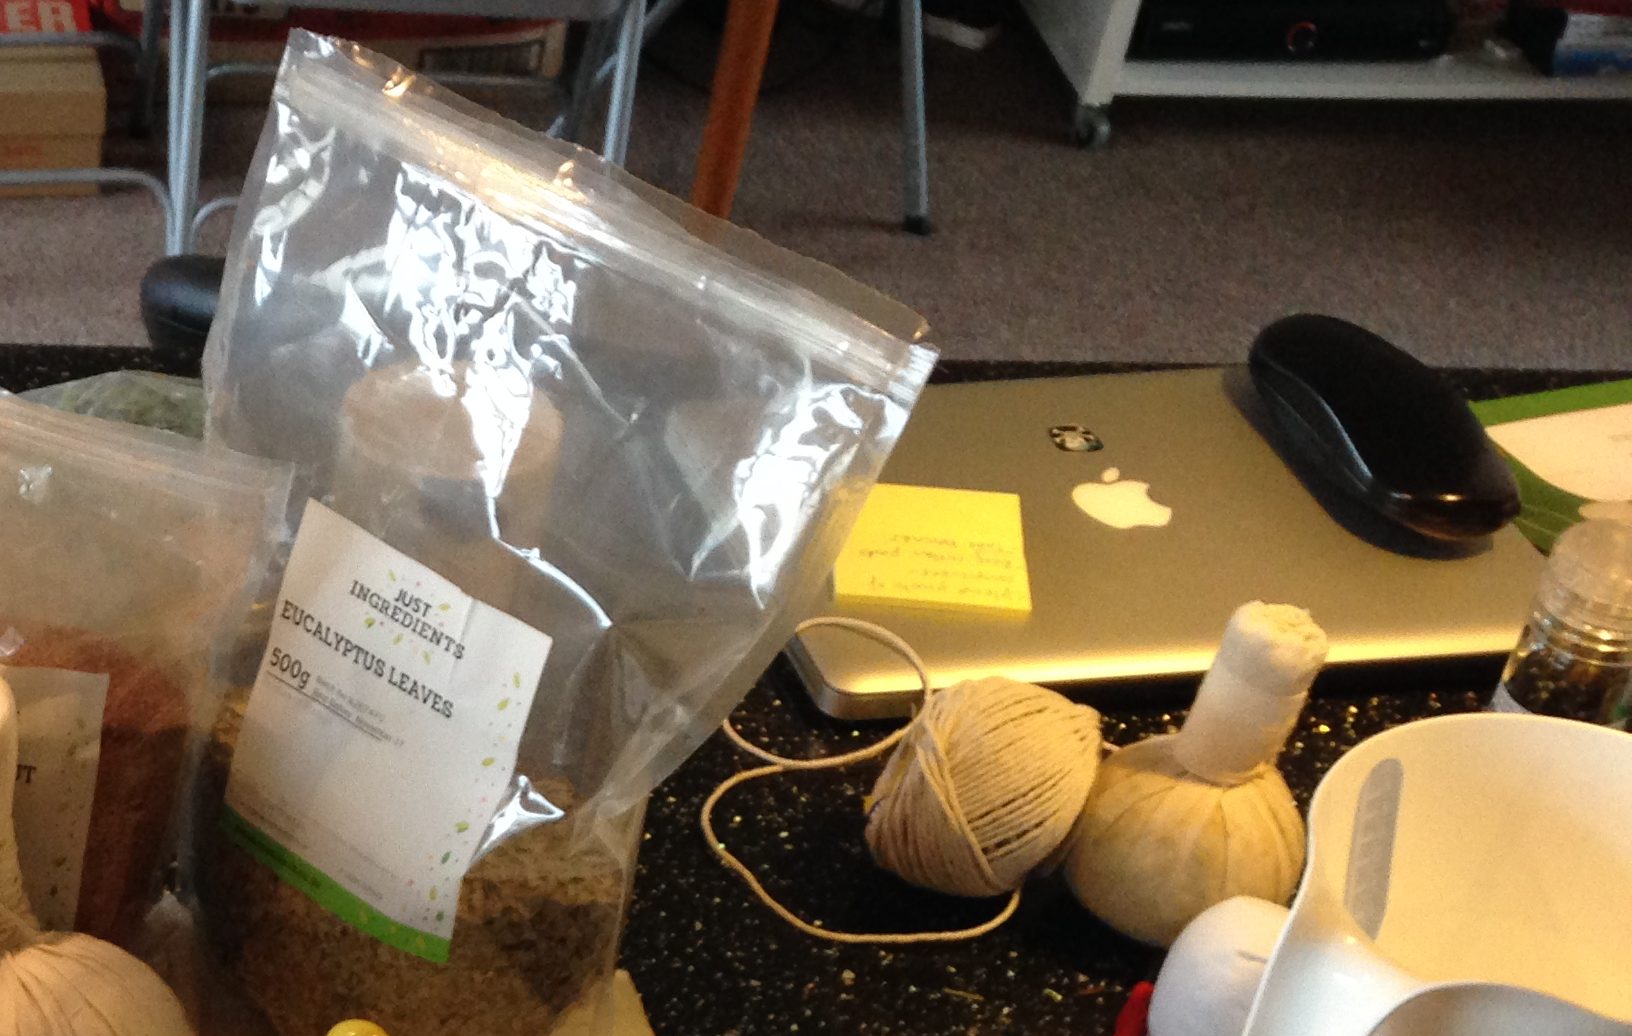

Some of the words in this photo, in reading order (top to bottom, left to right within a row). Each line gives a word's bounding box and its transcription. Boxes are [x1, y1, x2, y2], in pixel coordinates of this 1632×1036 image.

[349, 579, 466, 660] INGREDIENTS
[394, 588, 433, 619] JUST
[269, 645, 312, 690] 500g
[280, 599, 387, 679] EUCALYPTUS
[387, 665, 455, 719] LEAVES
